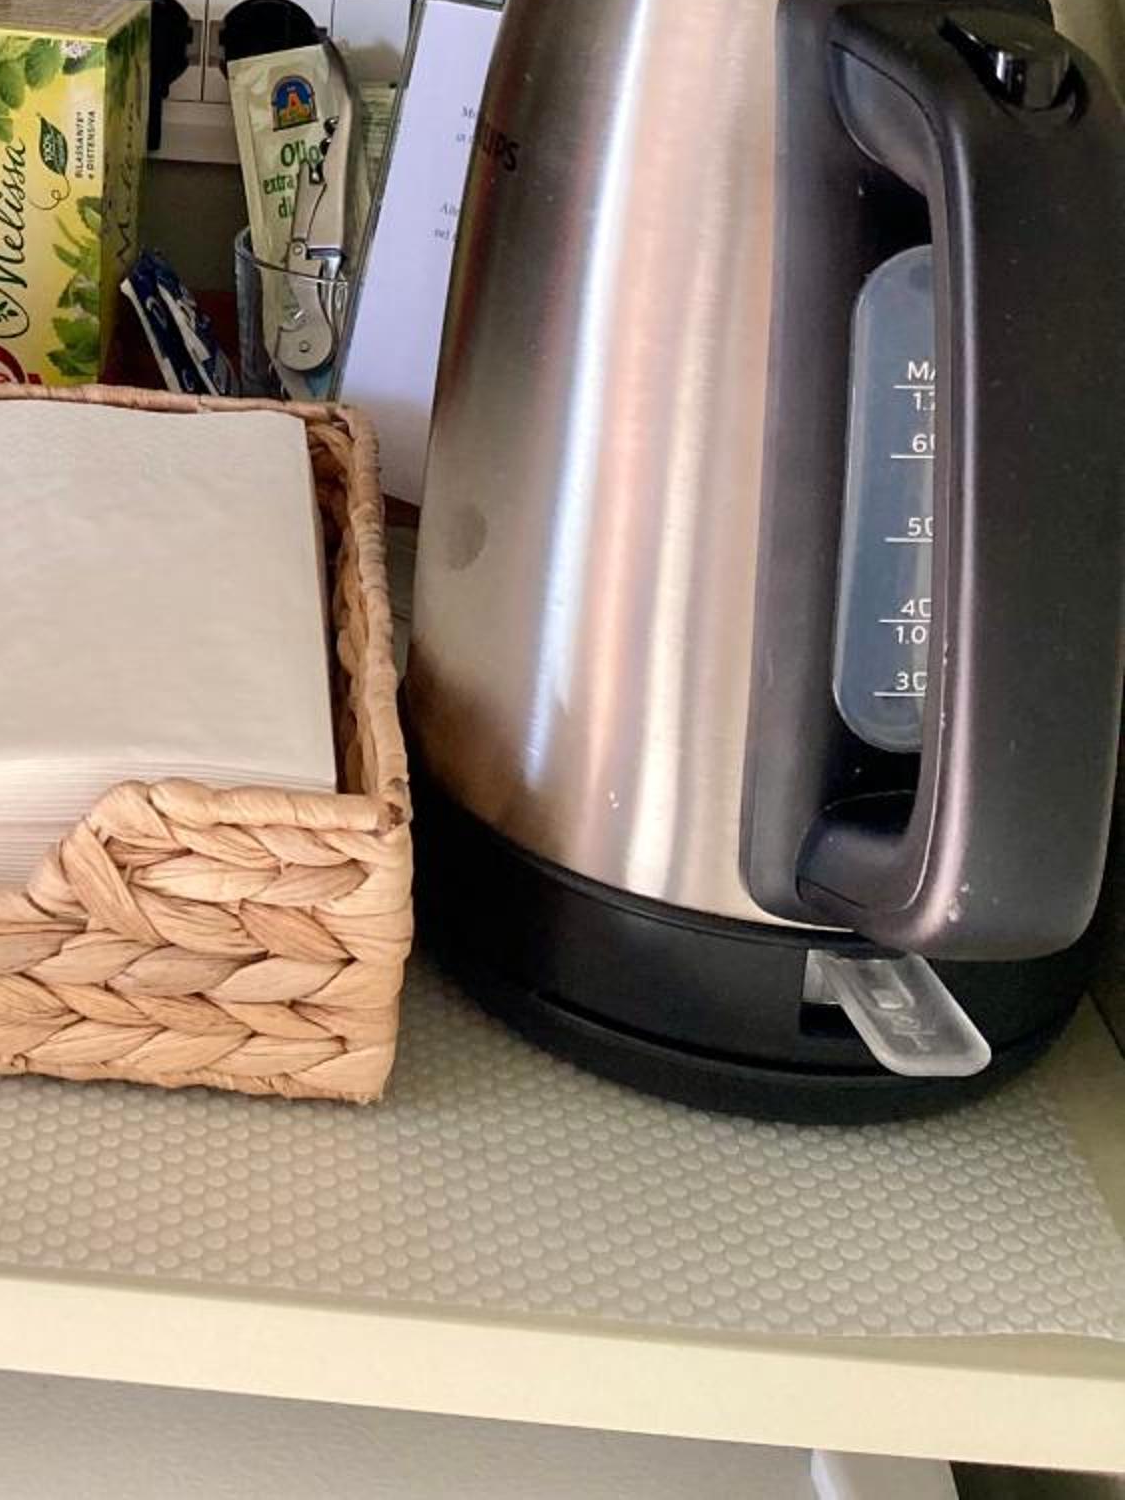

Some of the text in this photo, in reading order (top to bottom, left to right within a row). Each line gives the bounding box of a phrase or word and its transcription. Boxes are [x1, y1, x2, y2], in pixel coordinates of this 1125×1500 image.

[281, 139, 320, 167] Olio
[263, 173, 295, 195] extra
[895, 626, 926, 644] 1.0
